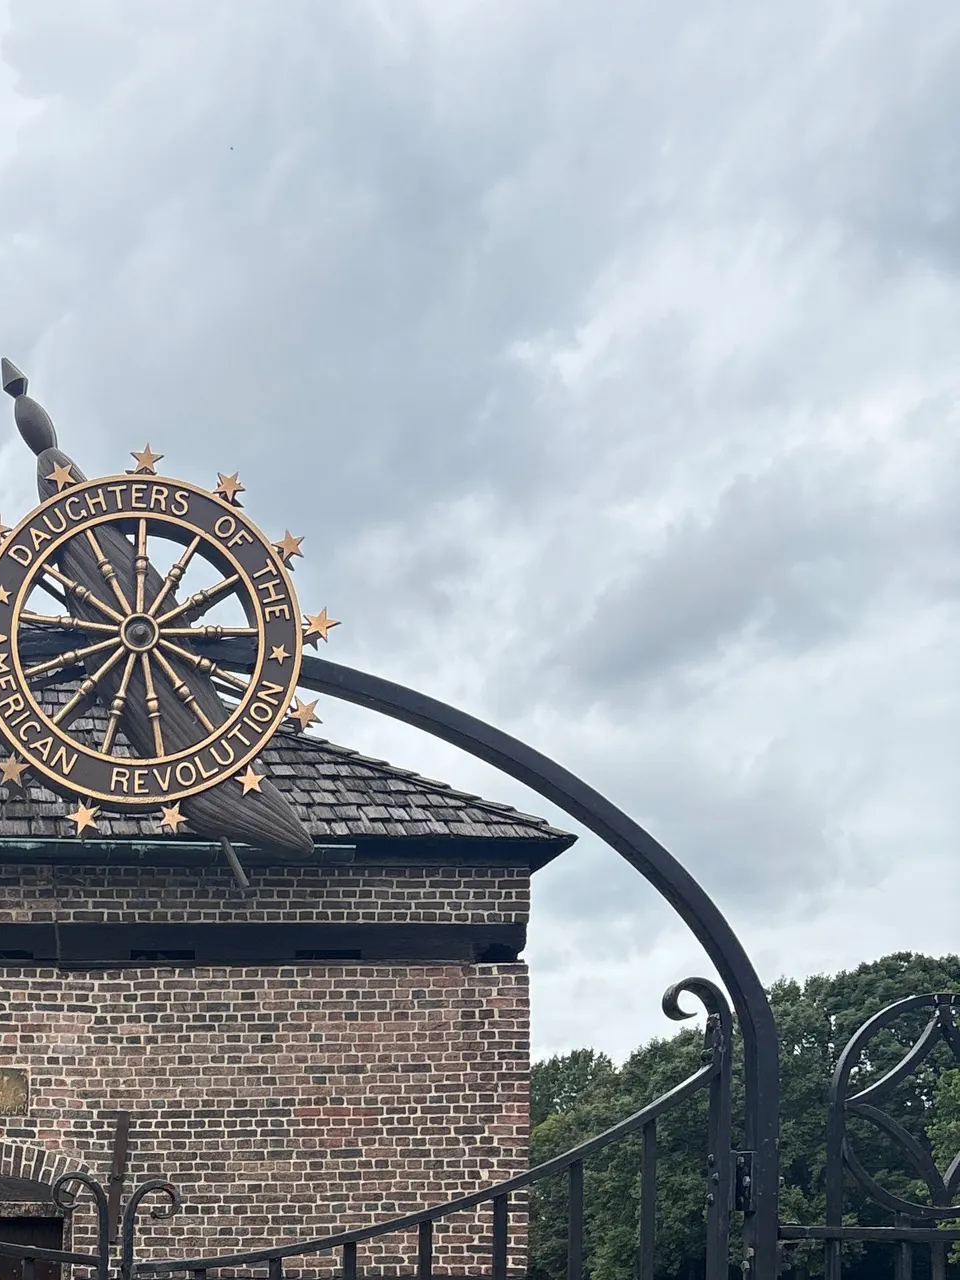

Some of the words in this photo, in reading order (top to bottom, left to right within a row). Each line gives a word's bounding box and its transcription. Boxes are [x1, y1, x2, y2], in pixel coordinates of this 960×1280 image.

[7, 484, 190, 567] DAUGHTERS
[213, 515, 254, 549] OF
[252, 557, 291, 622] THE
[110, 680, 285, 794] REVOLUTION
